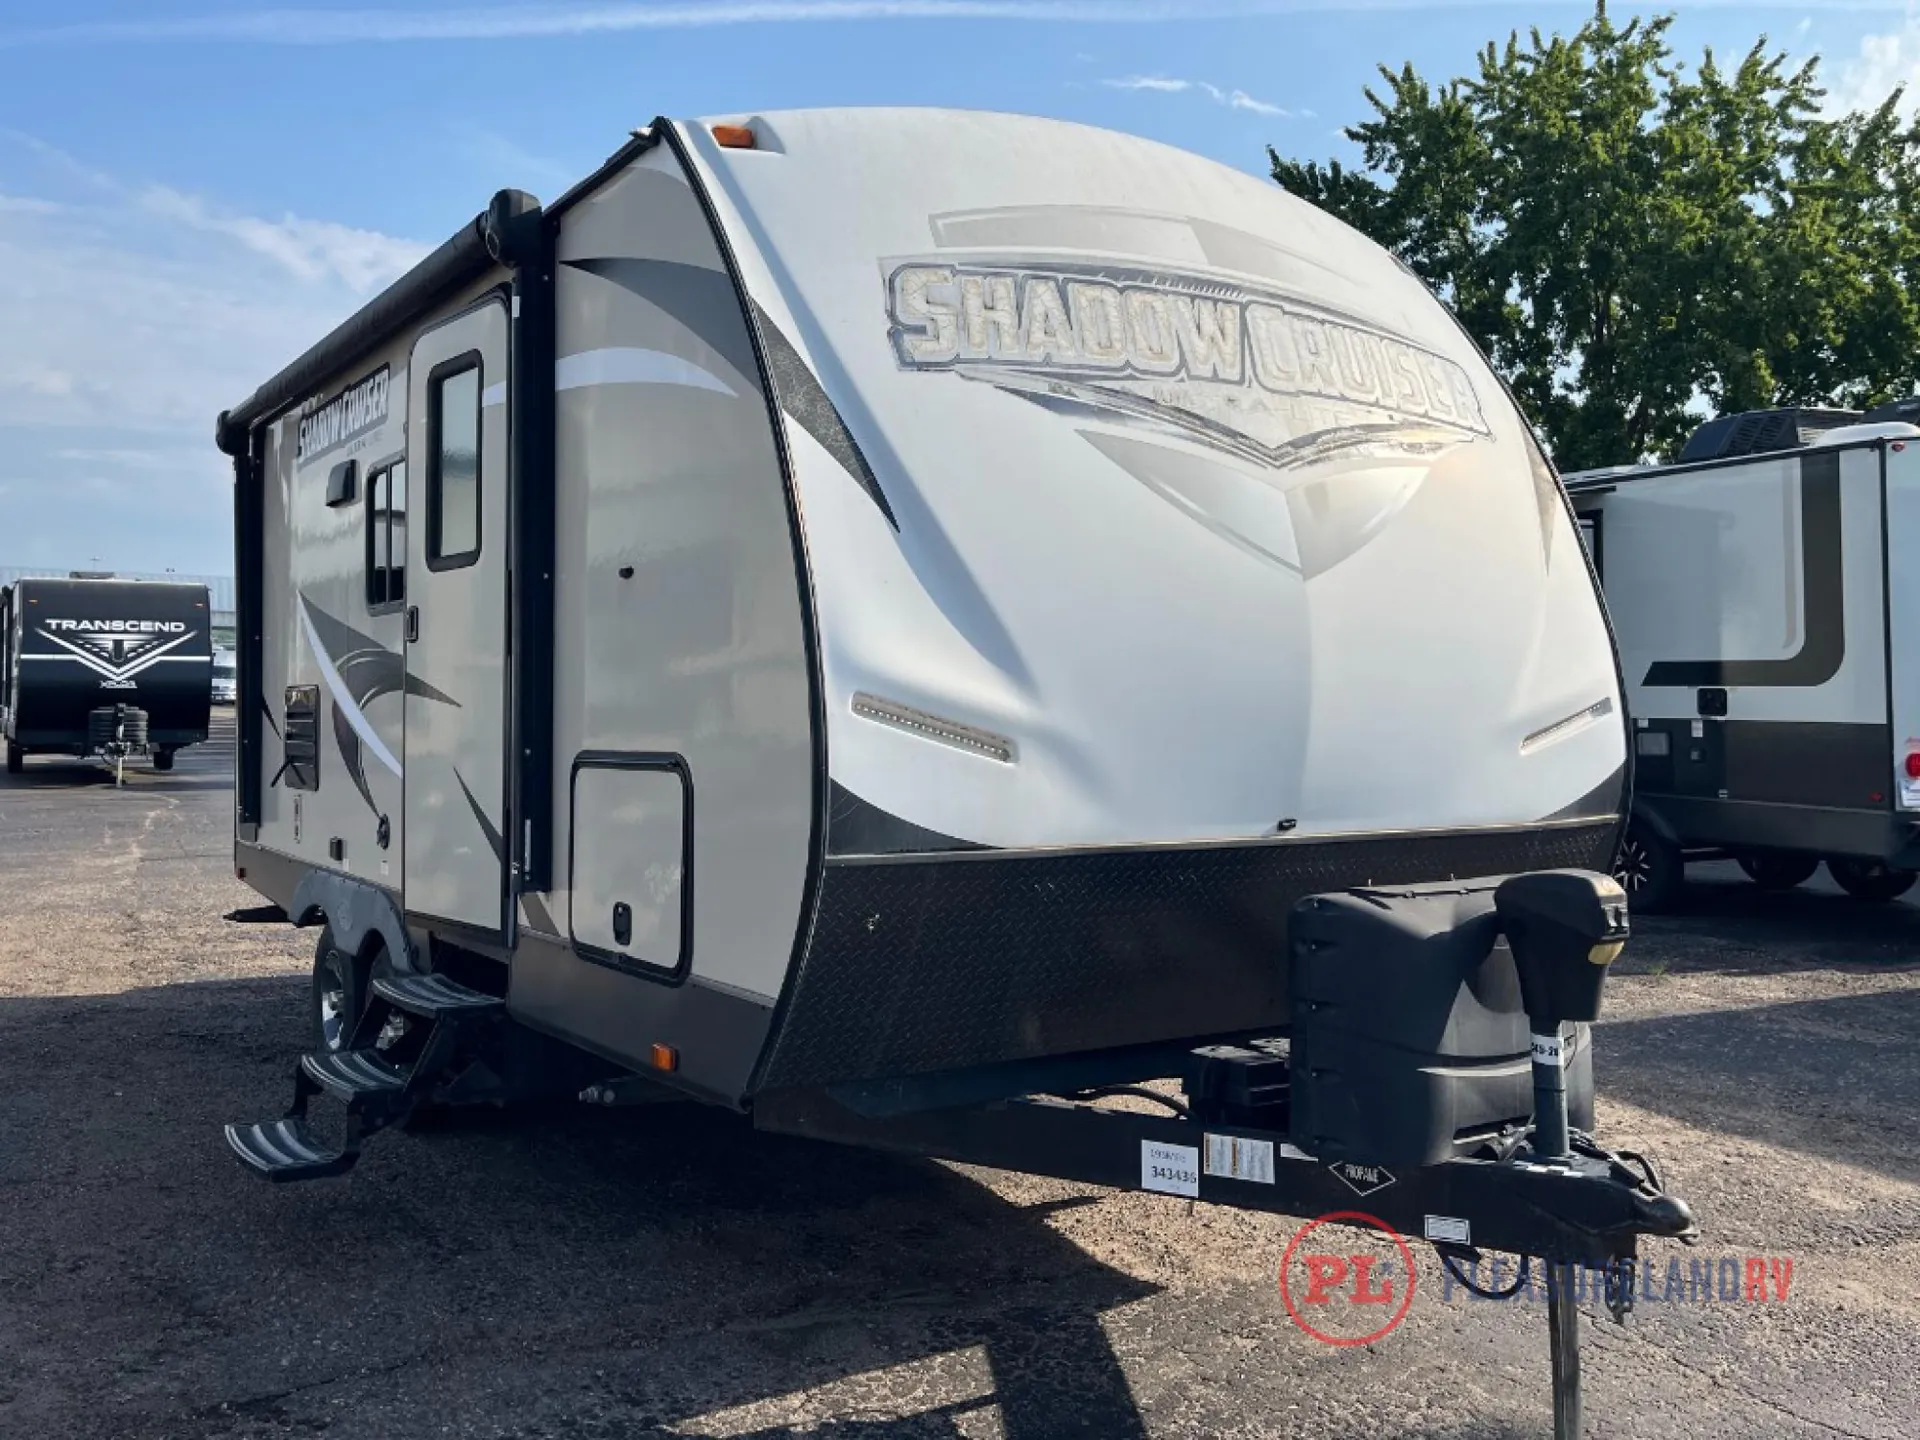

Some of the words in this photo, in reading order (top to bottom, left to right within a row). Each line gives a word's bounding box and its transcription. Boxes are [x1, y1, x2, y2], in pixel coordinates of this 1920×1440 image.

[897, 265, 1241, 382] SHADOW
[1246, 302, 1480, 426] CRUISER
[45, 618, 186, 633] TRANSCEND
